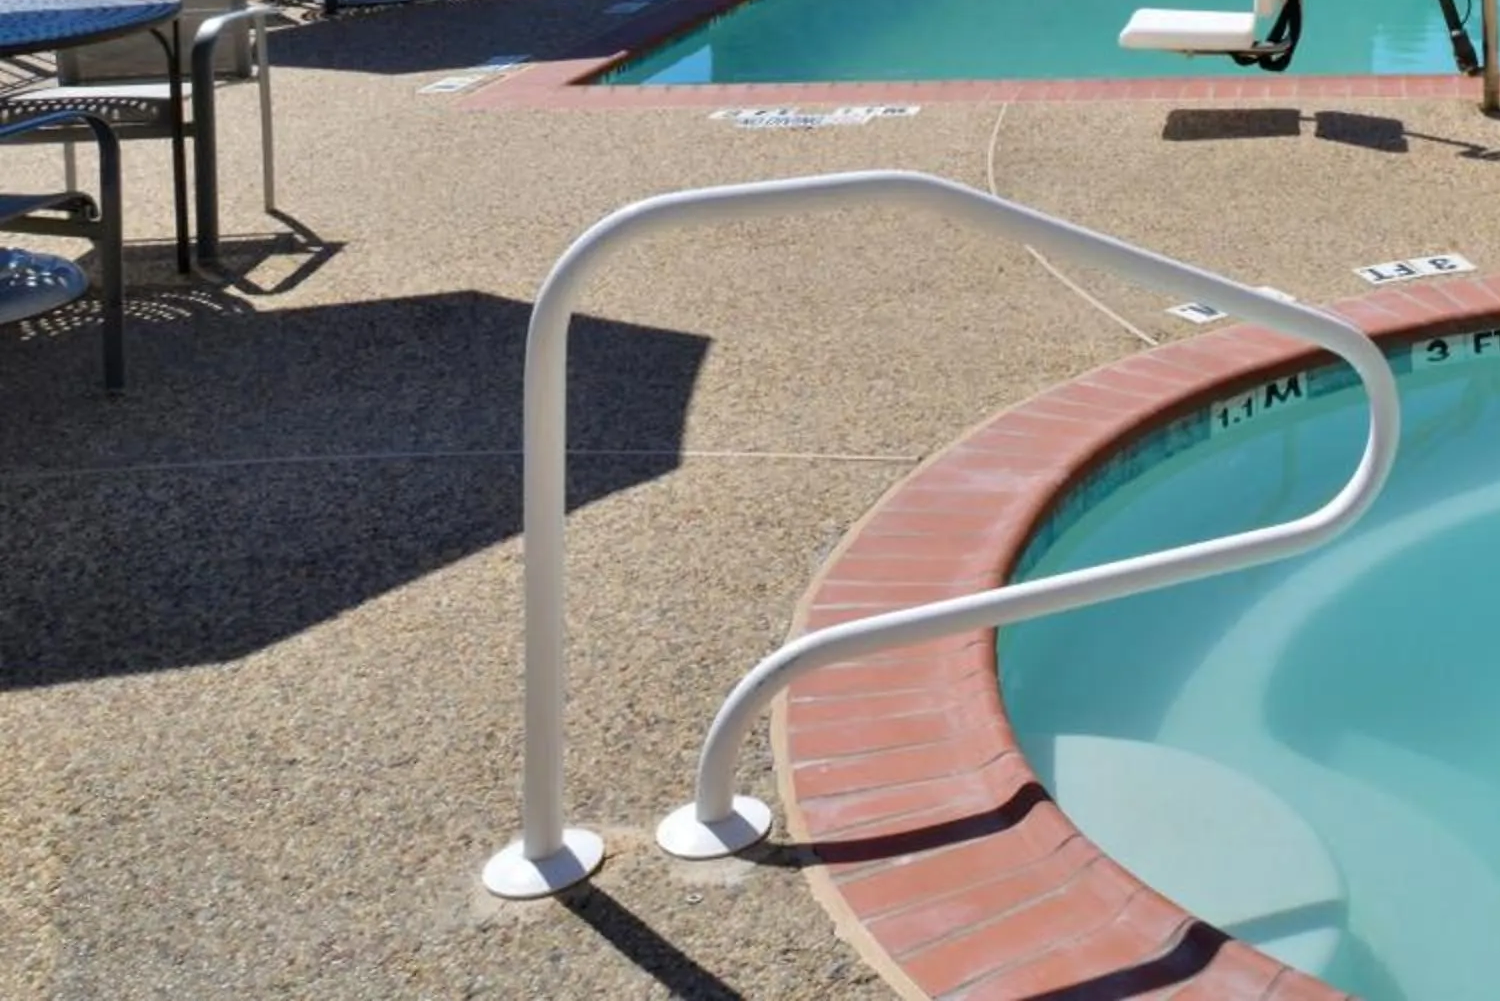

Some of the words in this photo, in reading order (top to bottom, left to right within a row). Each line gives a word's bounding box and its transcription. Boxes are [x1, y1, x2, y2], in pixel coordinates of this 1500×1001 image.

[1367, 263, 1417, 281] FT
[1427, 258, 1458, 270] 3
[1425, 339, 1450, 362] 3
[1218, 397, 1253, 429] 1.1
[1263, 374, 1303, 409] M
